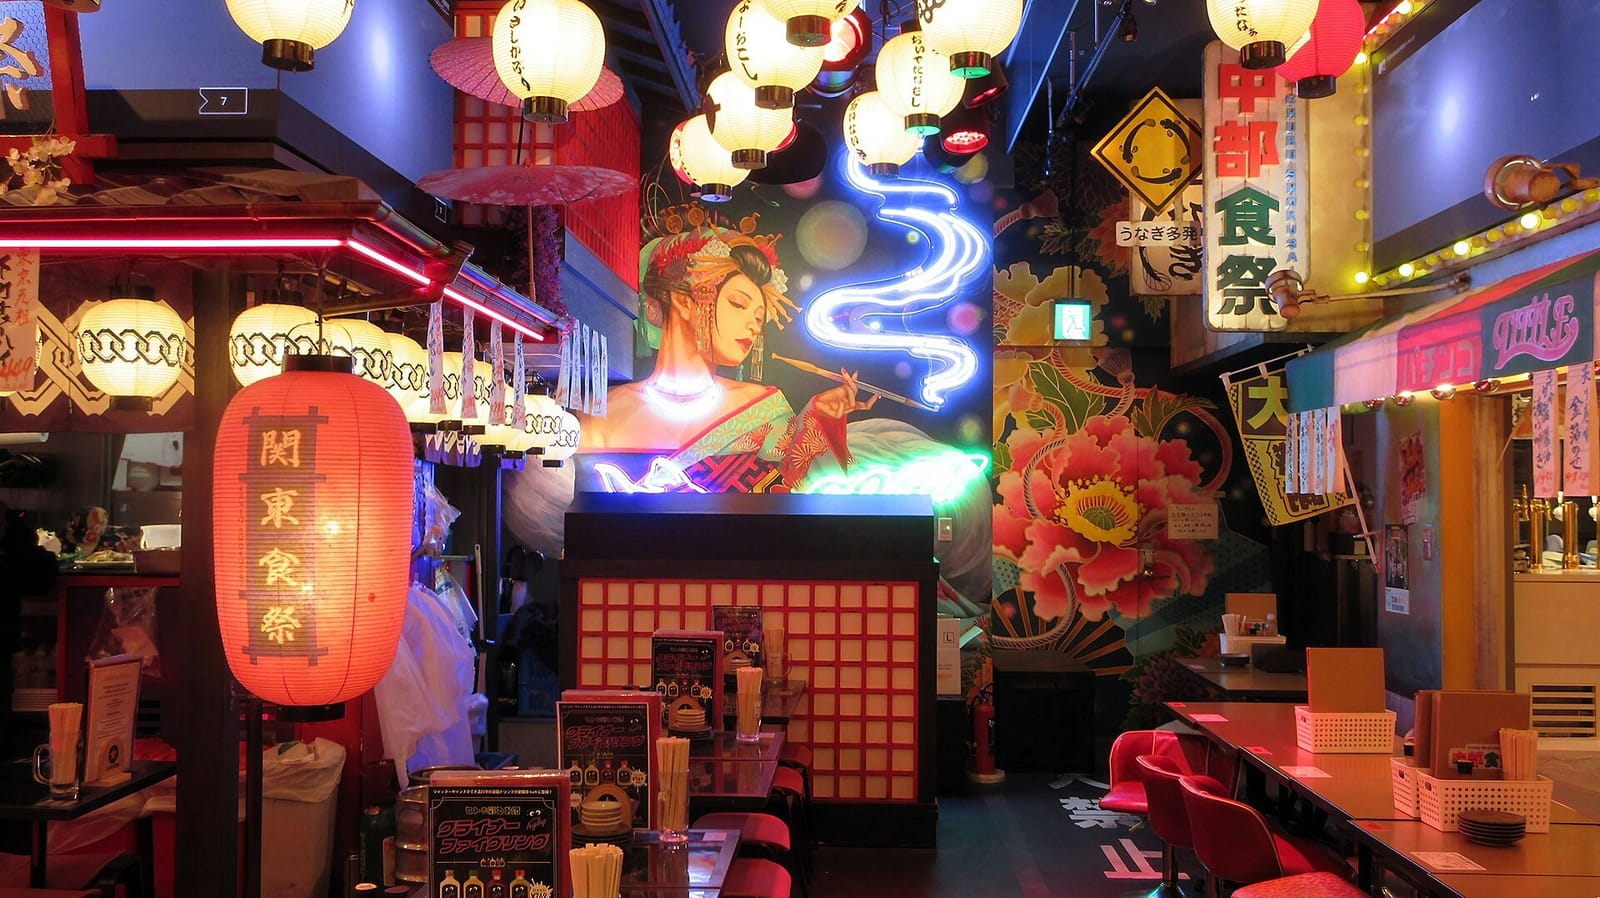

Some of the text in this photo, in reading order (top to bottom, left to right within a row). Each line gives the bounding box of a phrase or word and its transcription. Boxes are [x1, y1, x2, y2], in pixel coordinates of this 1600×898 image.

[220, 96, 228, 106] 7
[1213, 63, 1281, 316] 中部食祭
[1119, 226, 1198, 241] うなぎ多発
[258, 429, 302, 645] 関東食祭
[437, 817, 521, 837] クライナー
